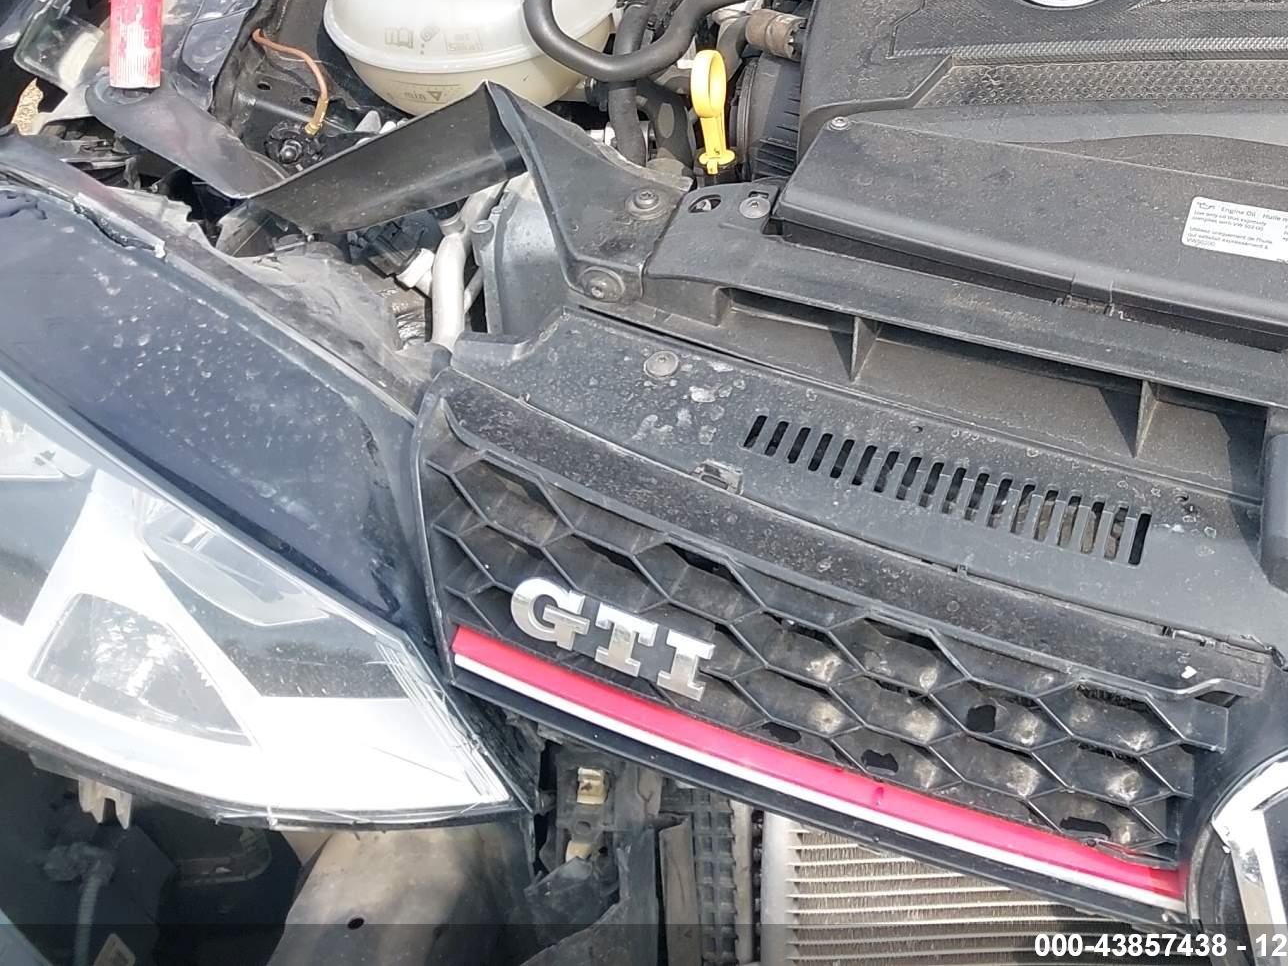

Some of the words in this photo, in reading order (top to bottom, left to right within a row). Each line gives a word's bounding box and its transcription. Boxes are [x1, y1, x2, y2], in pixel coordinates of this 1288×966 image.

[1220, 207, 1245, 216] Engine
[1246, 210, 1256, 218] Oil
[510, 576, 717, 702] GTI
